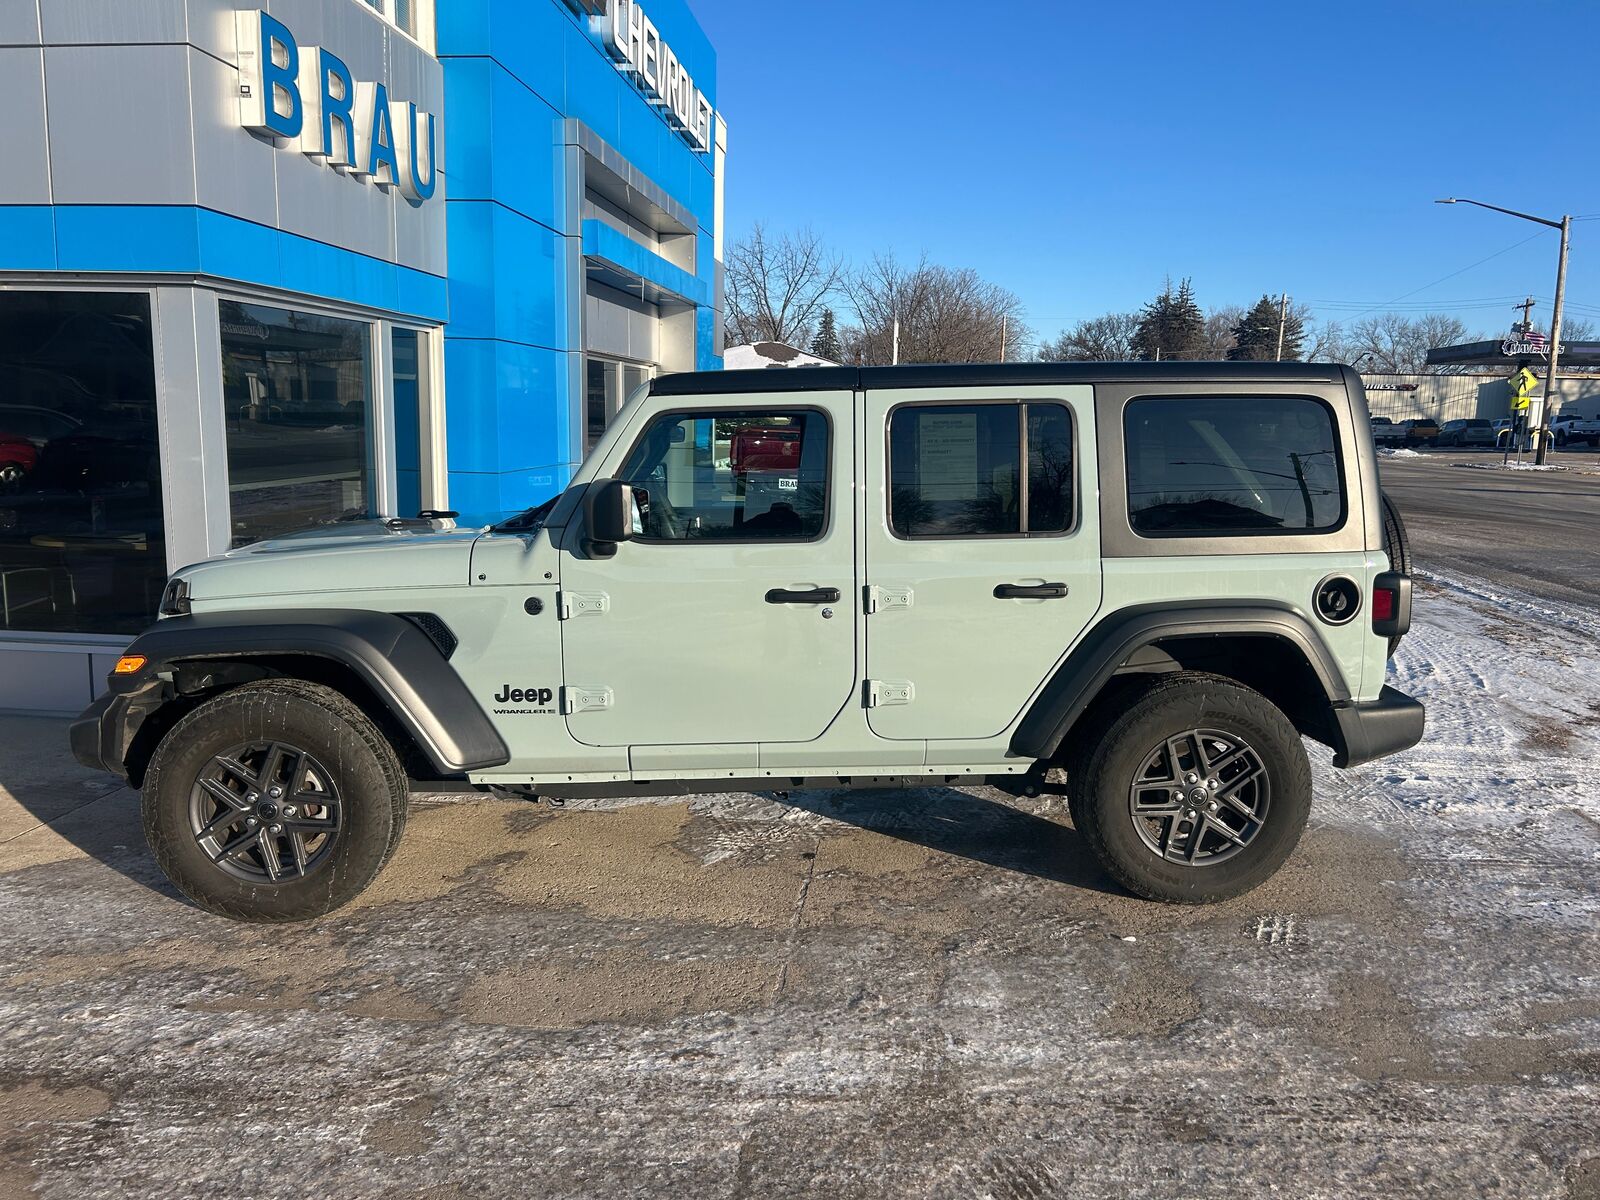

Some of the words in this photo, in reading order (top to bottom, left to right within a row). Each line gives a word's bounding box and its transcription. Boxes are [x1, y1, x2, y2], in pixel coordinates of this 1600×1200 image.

[255, 10, 436, 201] BRAU
[603, 0, 713, 154] CHEVROLET
[494, 684, 553, 706] Jeep
